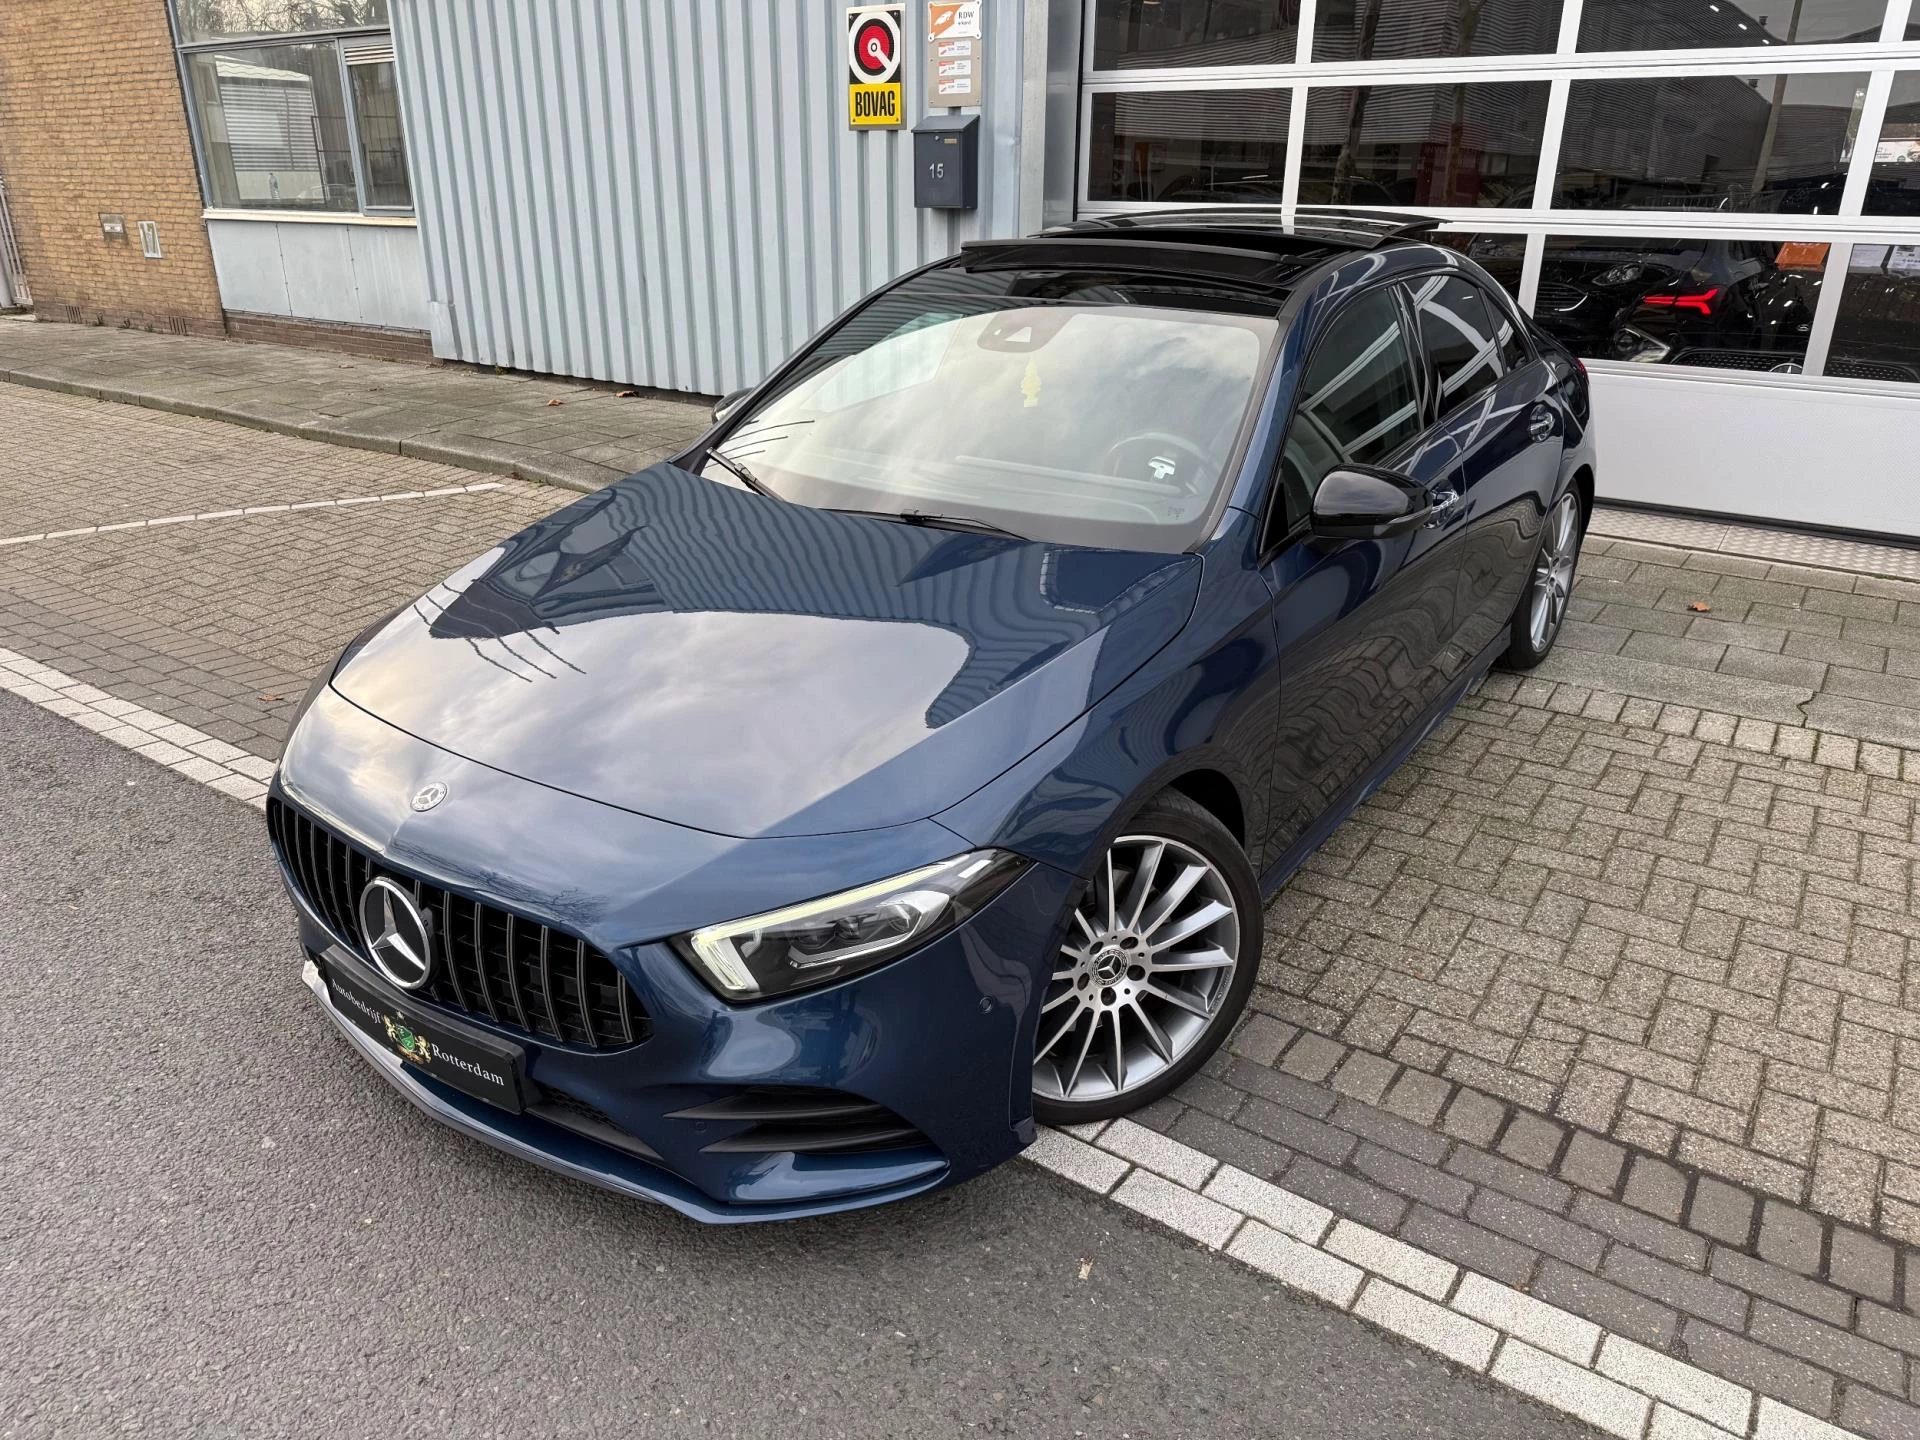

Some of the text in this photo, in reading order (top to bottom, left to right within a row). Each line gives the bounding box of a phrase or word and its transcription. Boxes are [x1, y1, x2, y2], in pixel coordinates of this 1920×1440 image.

[958, 11, 974, 19] RDW
[855, 90, 895, 117] BOVAG
[929, 163, 944, 178] 15
[431, 1043, 504, 1086] Rotterdam
